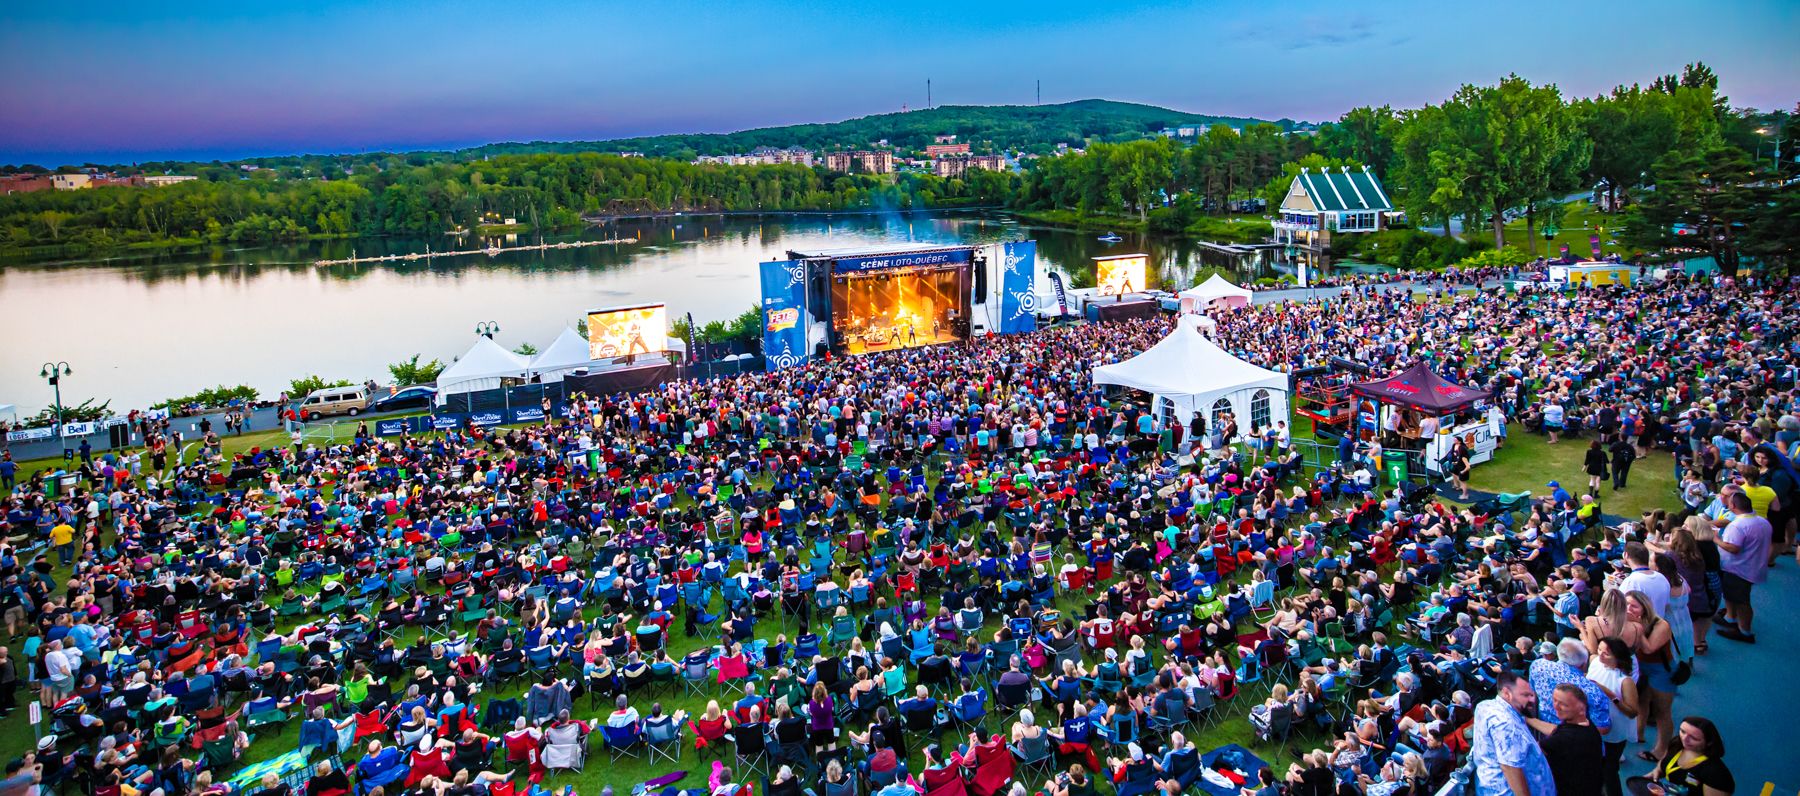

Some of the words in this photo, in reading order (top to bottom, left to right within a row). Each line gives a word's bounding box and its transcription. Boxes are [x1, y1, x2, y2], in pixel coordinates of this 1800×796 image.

[861, 258, 889, 269] SCÈNE
[891, 254, 948, 267] LOTO-QUÉBEC
[1386, 386, 1414, 396] LIGHT
[68, 424, 87, 434] Bell
